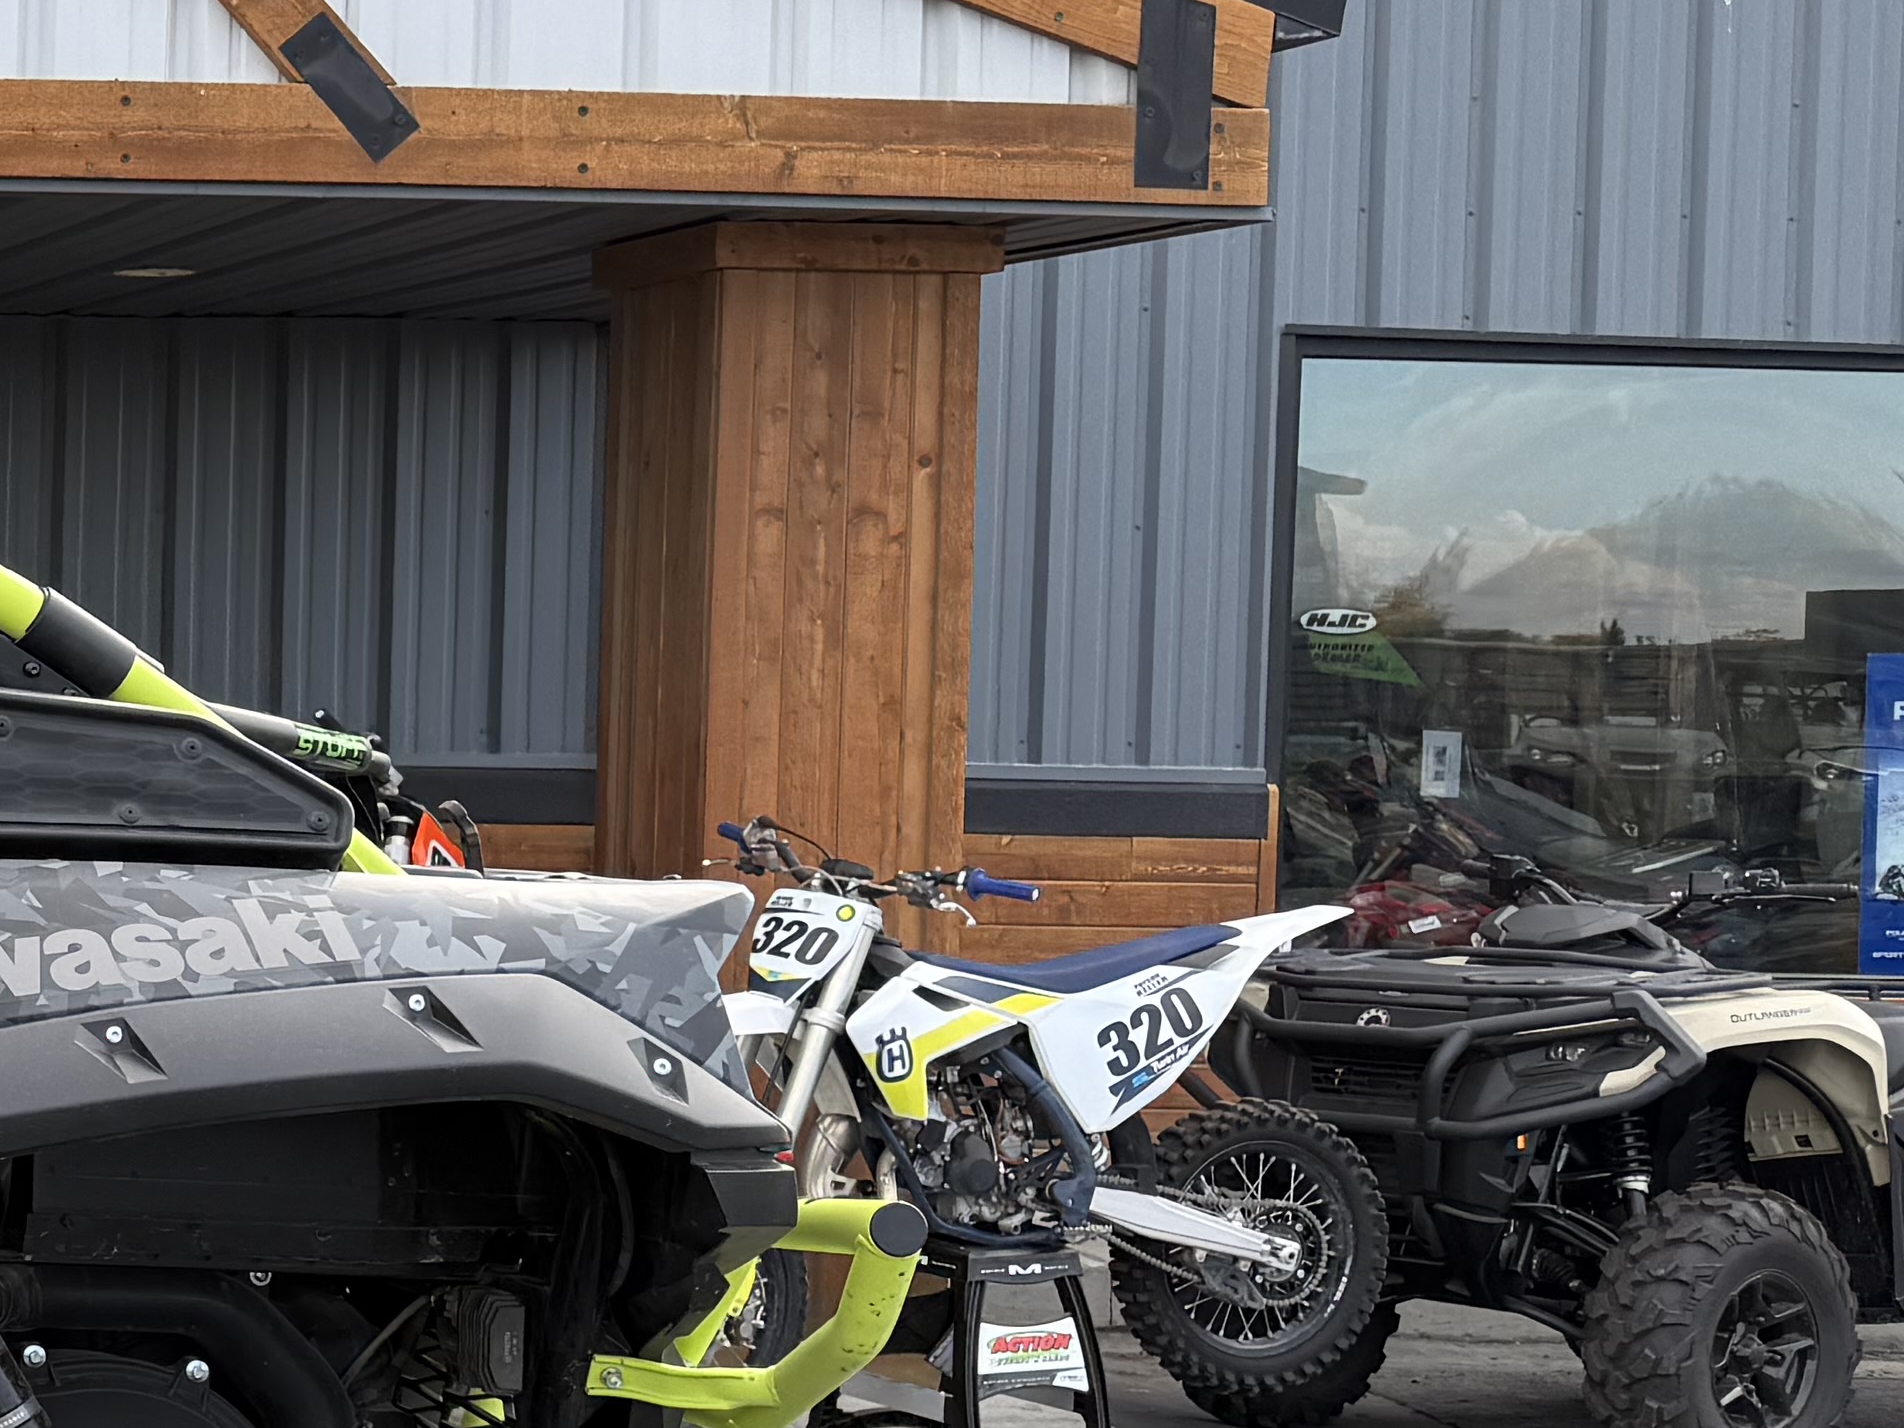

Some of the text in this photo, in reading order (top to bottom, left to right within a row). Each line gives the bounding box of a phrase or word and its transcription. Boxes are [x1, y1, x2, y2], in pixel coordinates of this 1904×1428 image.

[1305, 613, 1370, 628] HJC
[751, 916, 840, 965] 320
[1097, 987, 1204, 1077] 320
[991, 1333, 1072, 1354] ACTION
